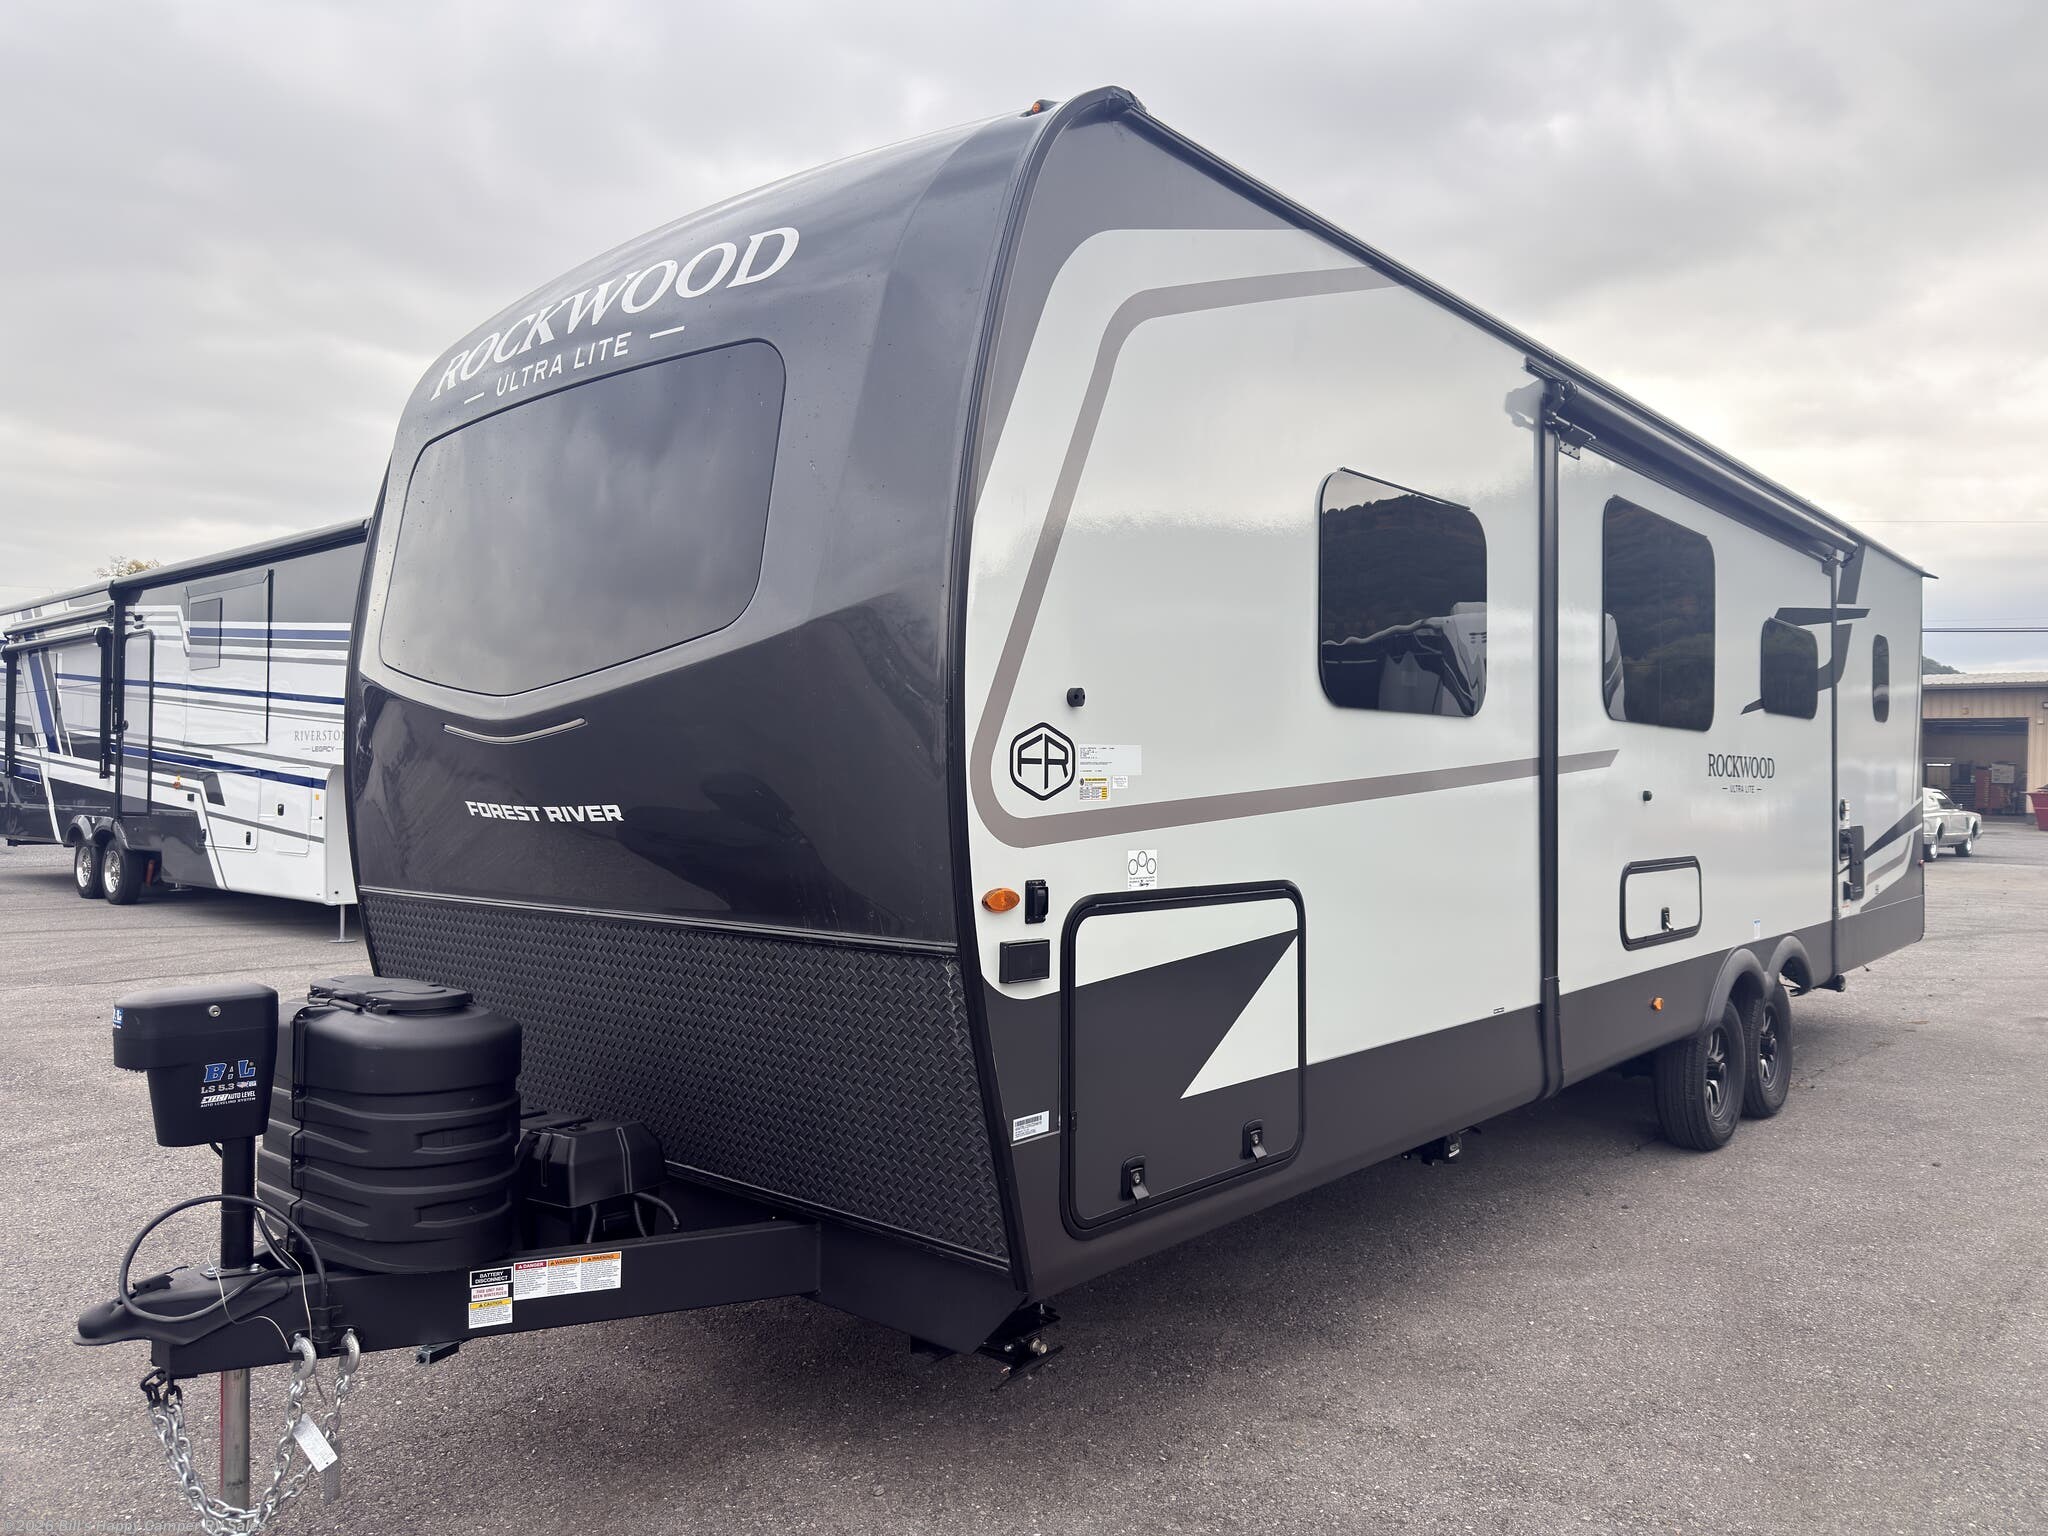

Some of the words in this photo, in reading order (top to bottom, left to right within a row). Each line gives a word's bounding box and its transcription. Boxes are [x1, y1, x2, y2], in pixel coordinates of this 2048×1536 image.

[431, 227, 800, 401] ROCKWOOD
[496, 355, 563, 397] ULTRA
[574, 332, 633, 371] LITE
[1708, 753, 1775, 779] ROCKWOOD
[465, 801, 540, 822] FOREST
[542, 804, 625, 822] RIVER
[201, 1086, 216, 1094] LS
[218, 1083, 235, 1091] 5.3
[228, 1092, 241, 1100] AUTO
[242, 1090, 256, 1098] LEVEL
[523, 1261, 544, 1269] DANGER
[475, 1275, 508, 1284] DISCONNECT
[480, 1271, 504, 1279] BATTERY
